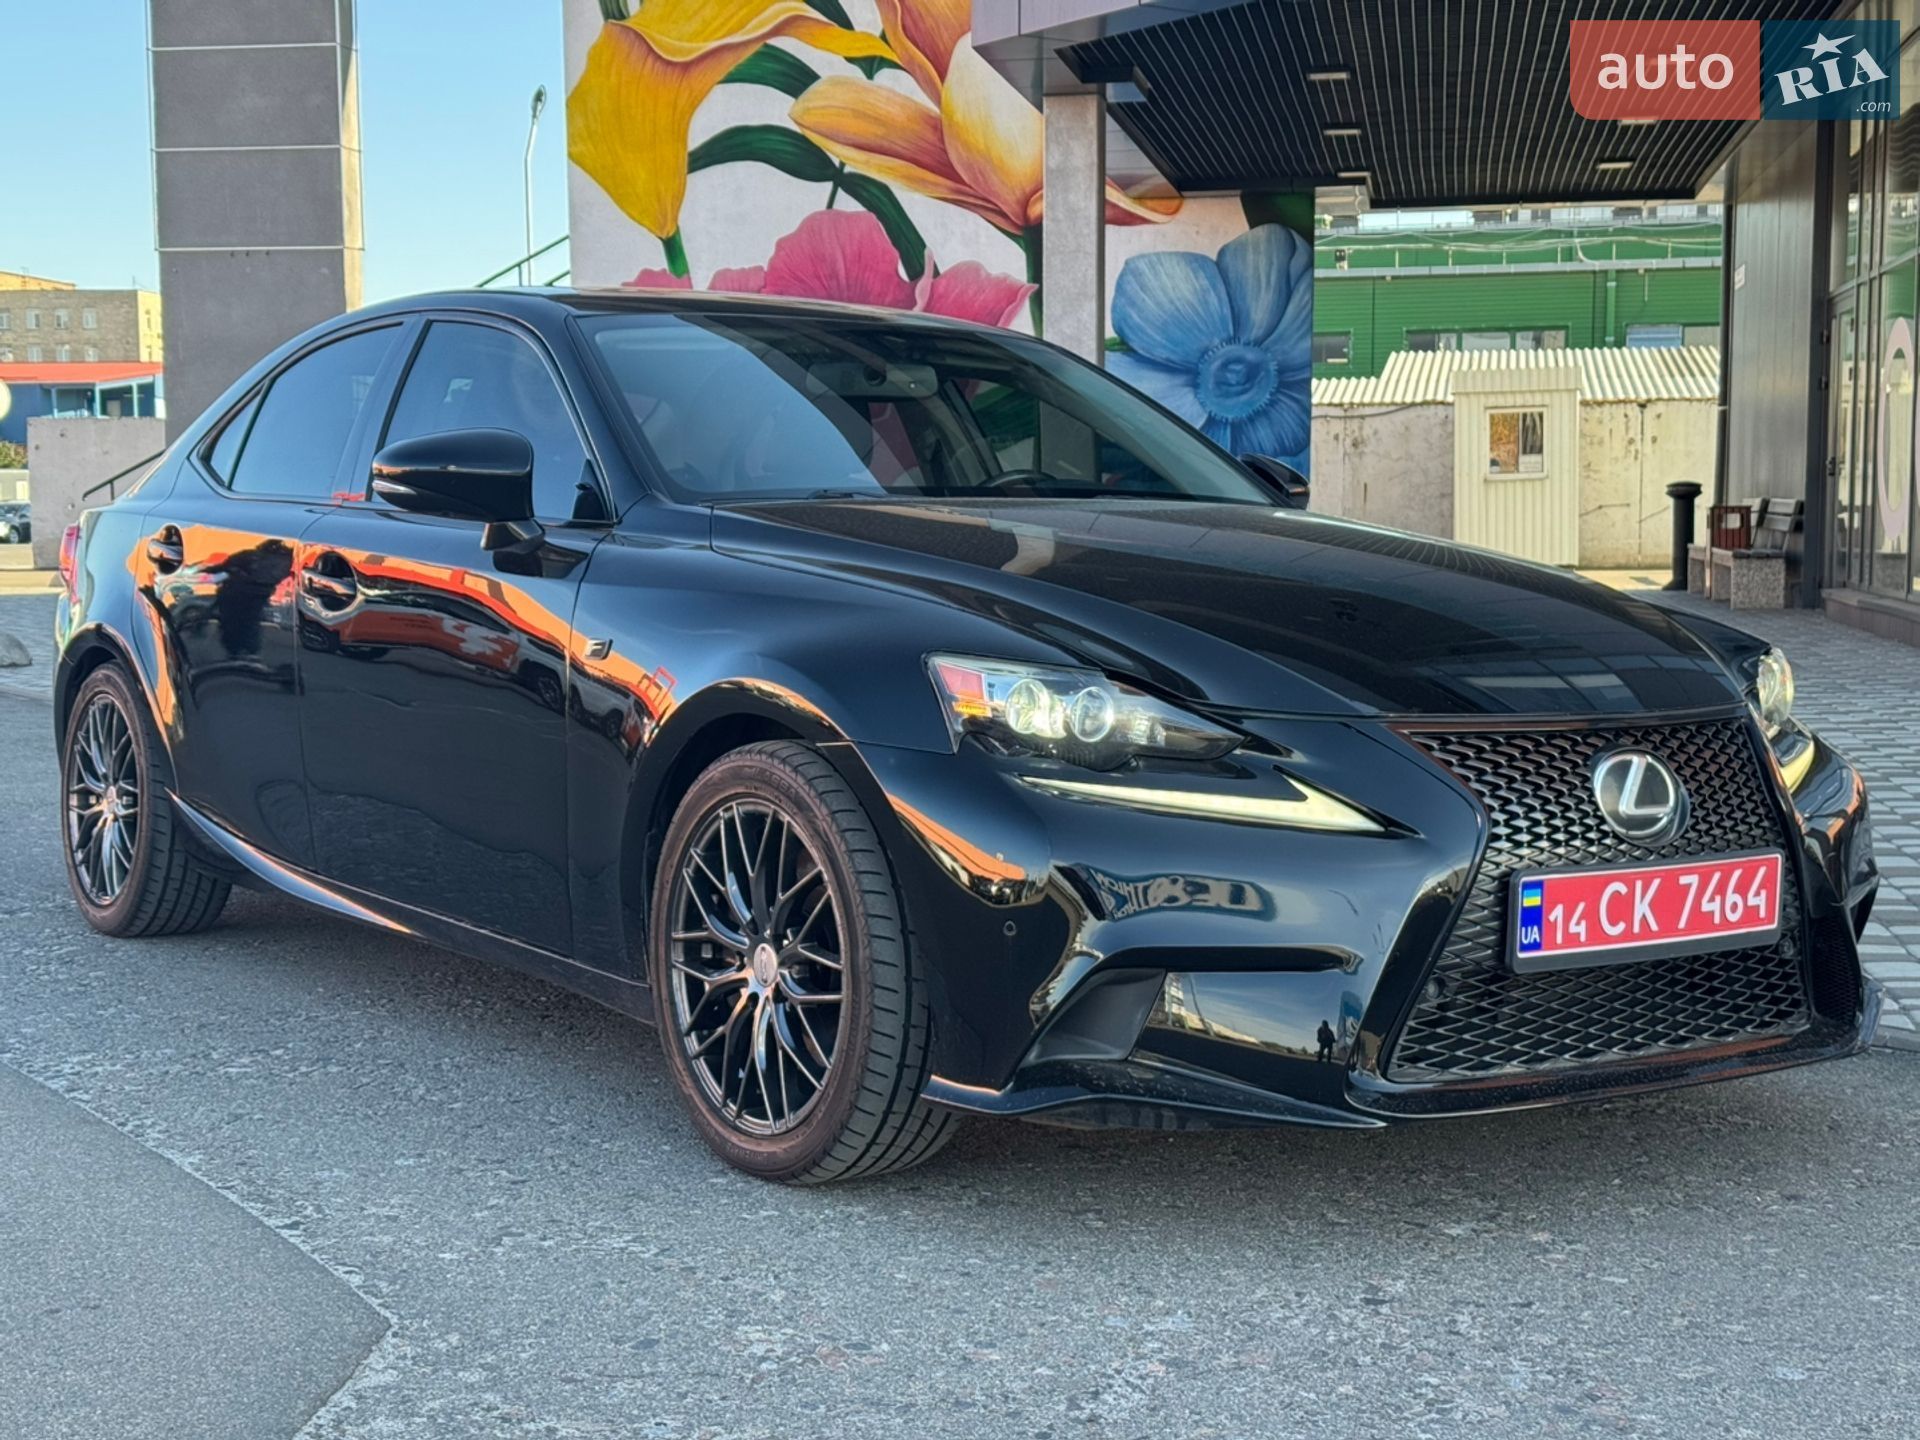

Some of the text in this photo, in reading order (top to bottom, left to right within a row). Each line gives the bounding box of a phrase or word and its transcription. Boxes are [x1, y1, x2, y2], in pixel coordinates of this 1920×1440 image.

[1548, 865, 1768, 945] 14 CK 7464
[1521, 925, 1540, 944] UA
